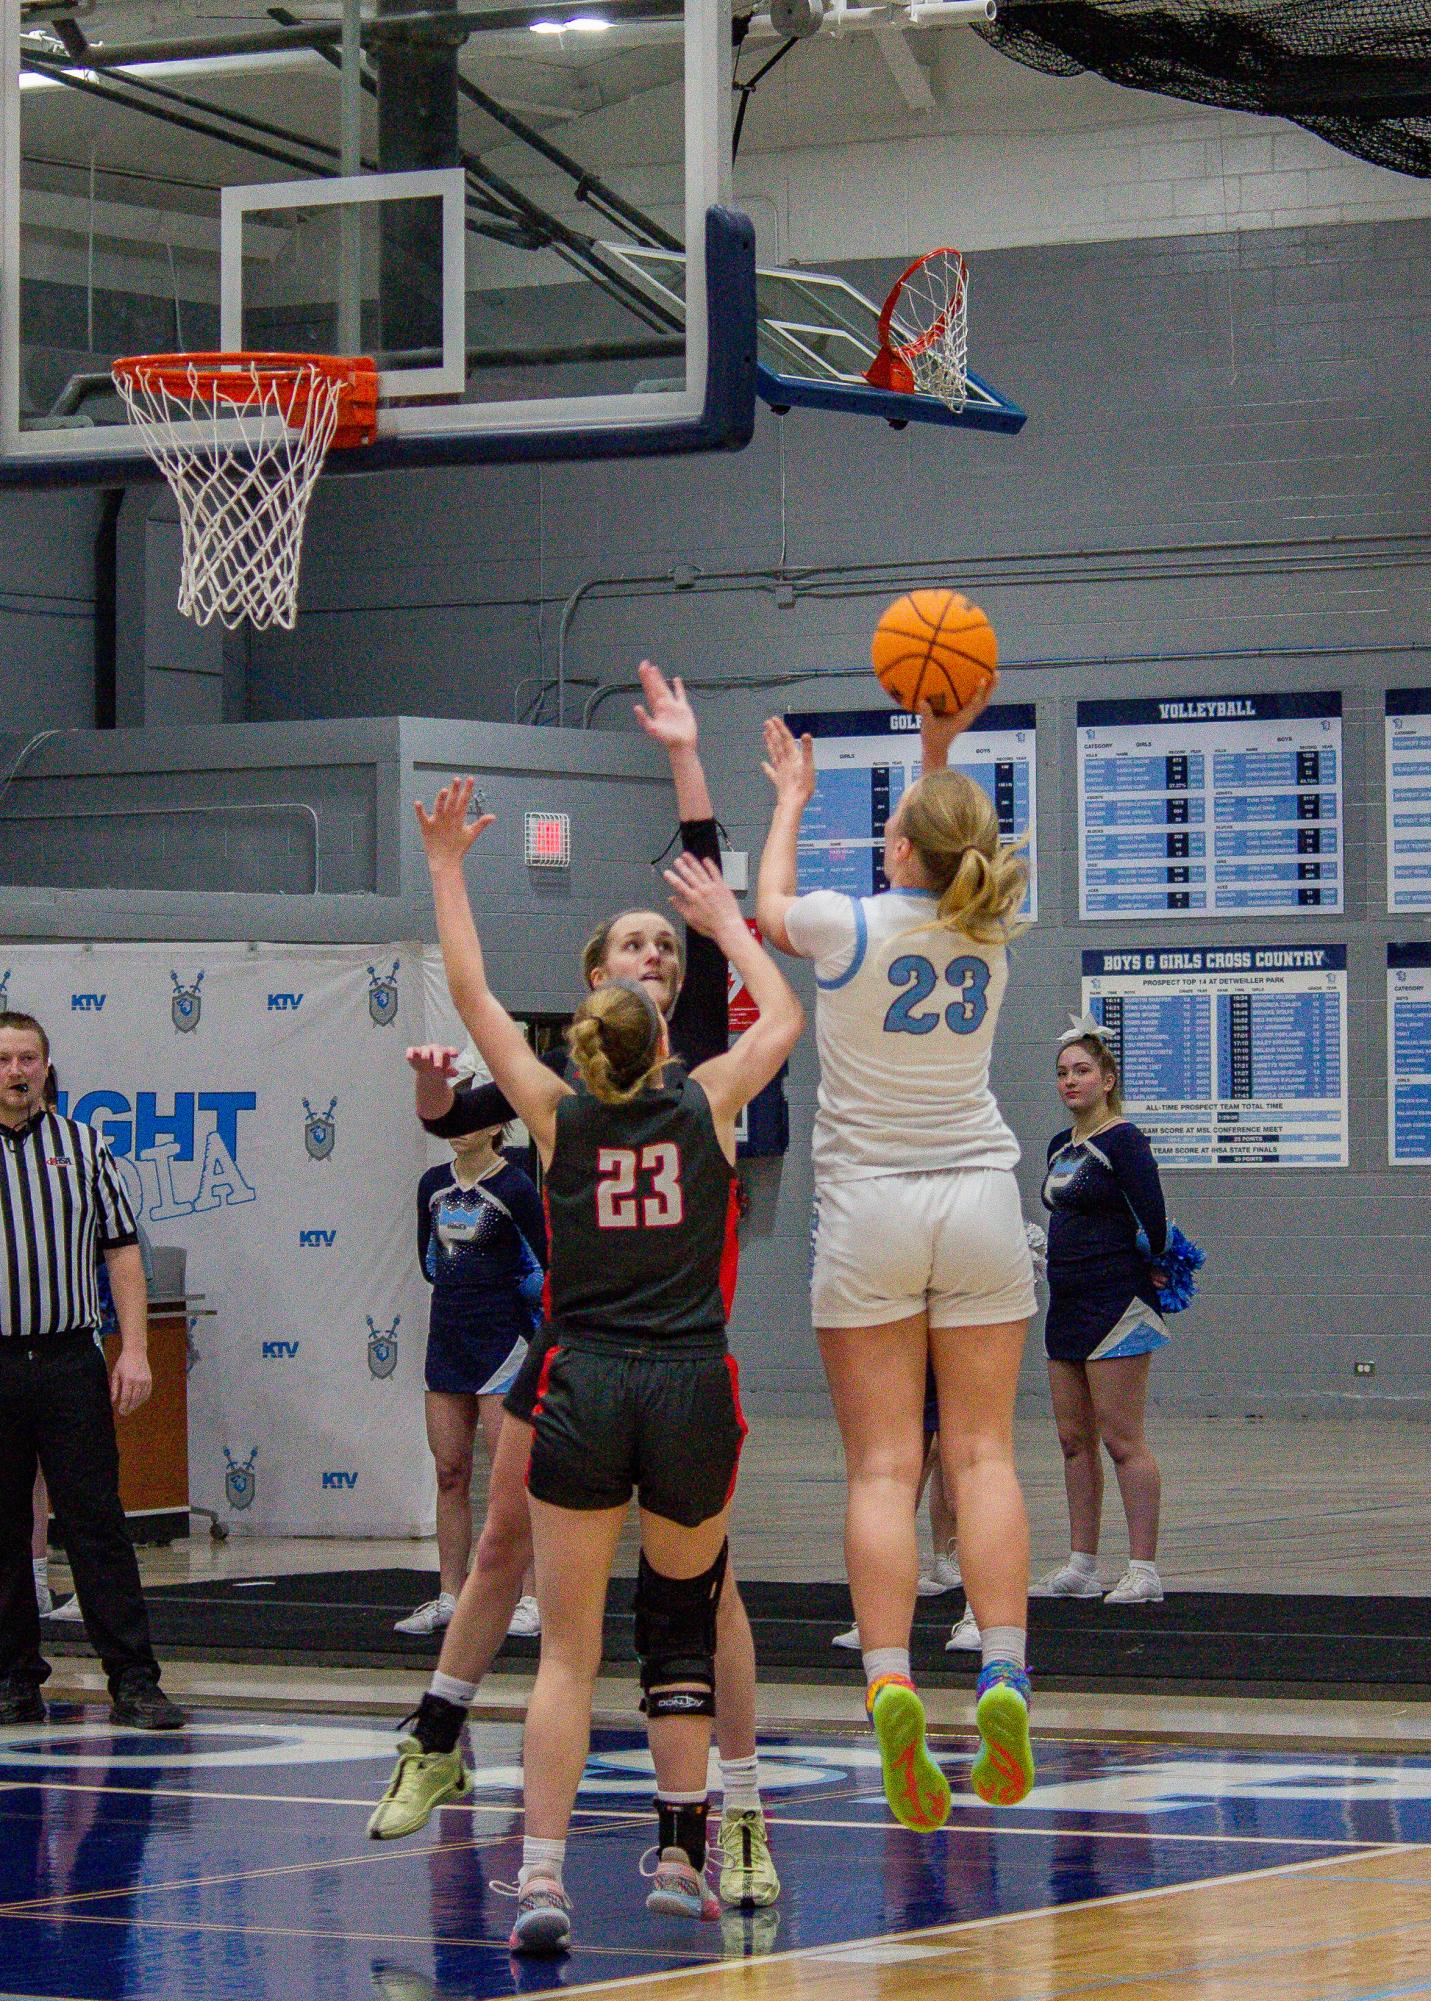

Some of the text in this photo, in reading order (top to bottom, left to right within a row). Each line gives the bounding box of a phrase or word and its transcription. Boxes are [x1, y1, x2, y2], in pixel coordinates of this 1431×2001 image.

[1159, 701, 1256, 719] VOLLEYBALL
[890, 714, 922, 730] GOLF
[1104, 950, 1325, 971] BOYS & GIRLS CROSS COUNTRY
[71, 993, 107, 1011] KTV
[267, 993, 304, 1011] KTV
[883, 954, 992, 1036] 23
[1160, 1126, 1184, 1134] SCORE
[596, 1140, 685, 1229] 23
[299, 1230, 337, 1248] KTV
[262, 1341, 299, 1359] KTV
[322, 1472, 359, 1489] KTV
[658, 1695, 704, 1708] DONJOY
